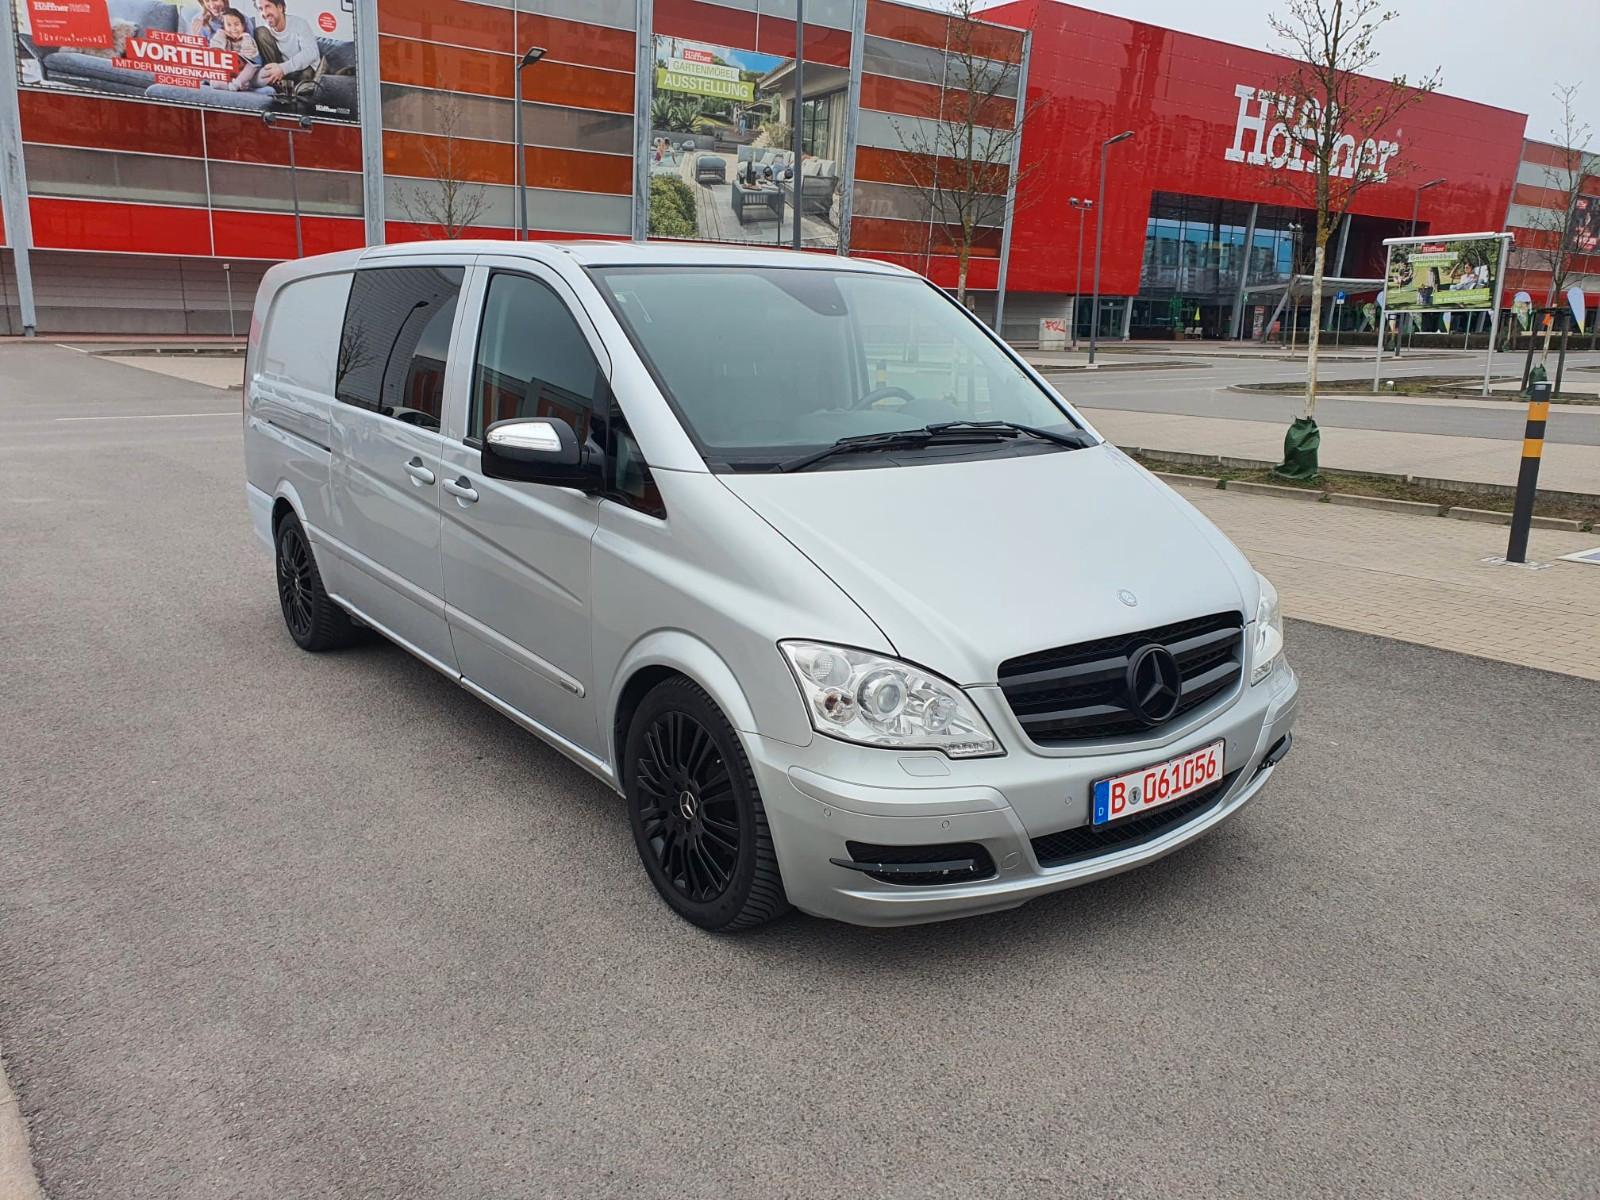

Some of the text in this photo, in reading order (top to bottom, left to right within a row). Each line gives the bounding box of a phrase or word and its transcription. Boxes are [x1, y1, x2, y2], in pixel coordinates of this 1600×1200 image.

[150, 31, 205, 46] JETZT VIELE
[131, 40, 234, 70] VORTEILE
[115, 59, 228, 81] MIT DER KUNDENKARTE
[157, 75, 197, 88] SICHERN!
[663, 74, 749, 97] AUSSTELLUNG
[1098, 750, 1217, 817] D B 061056
